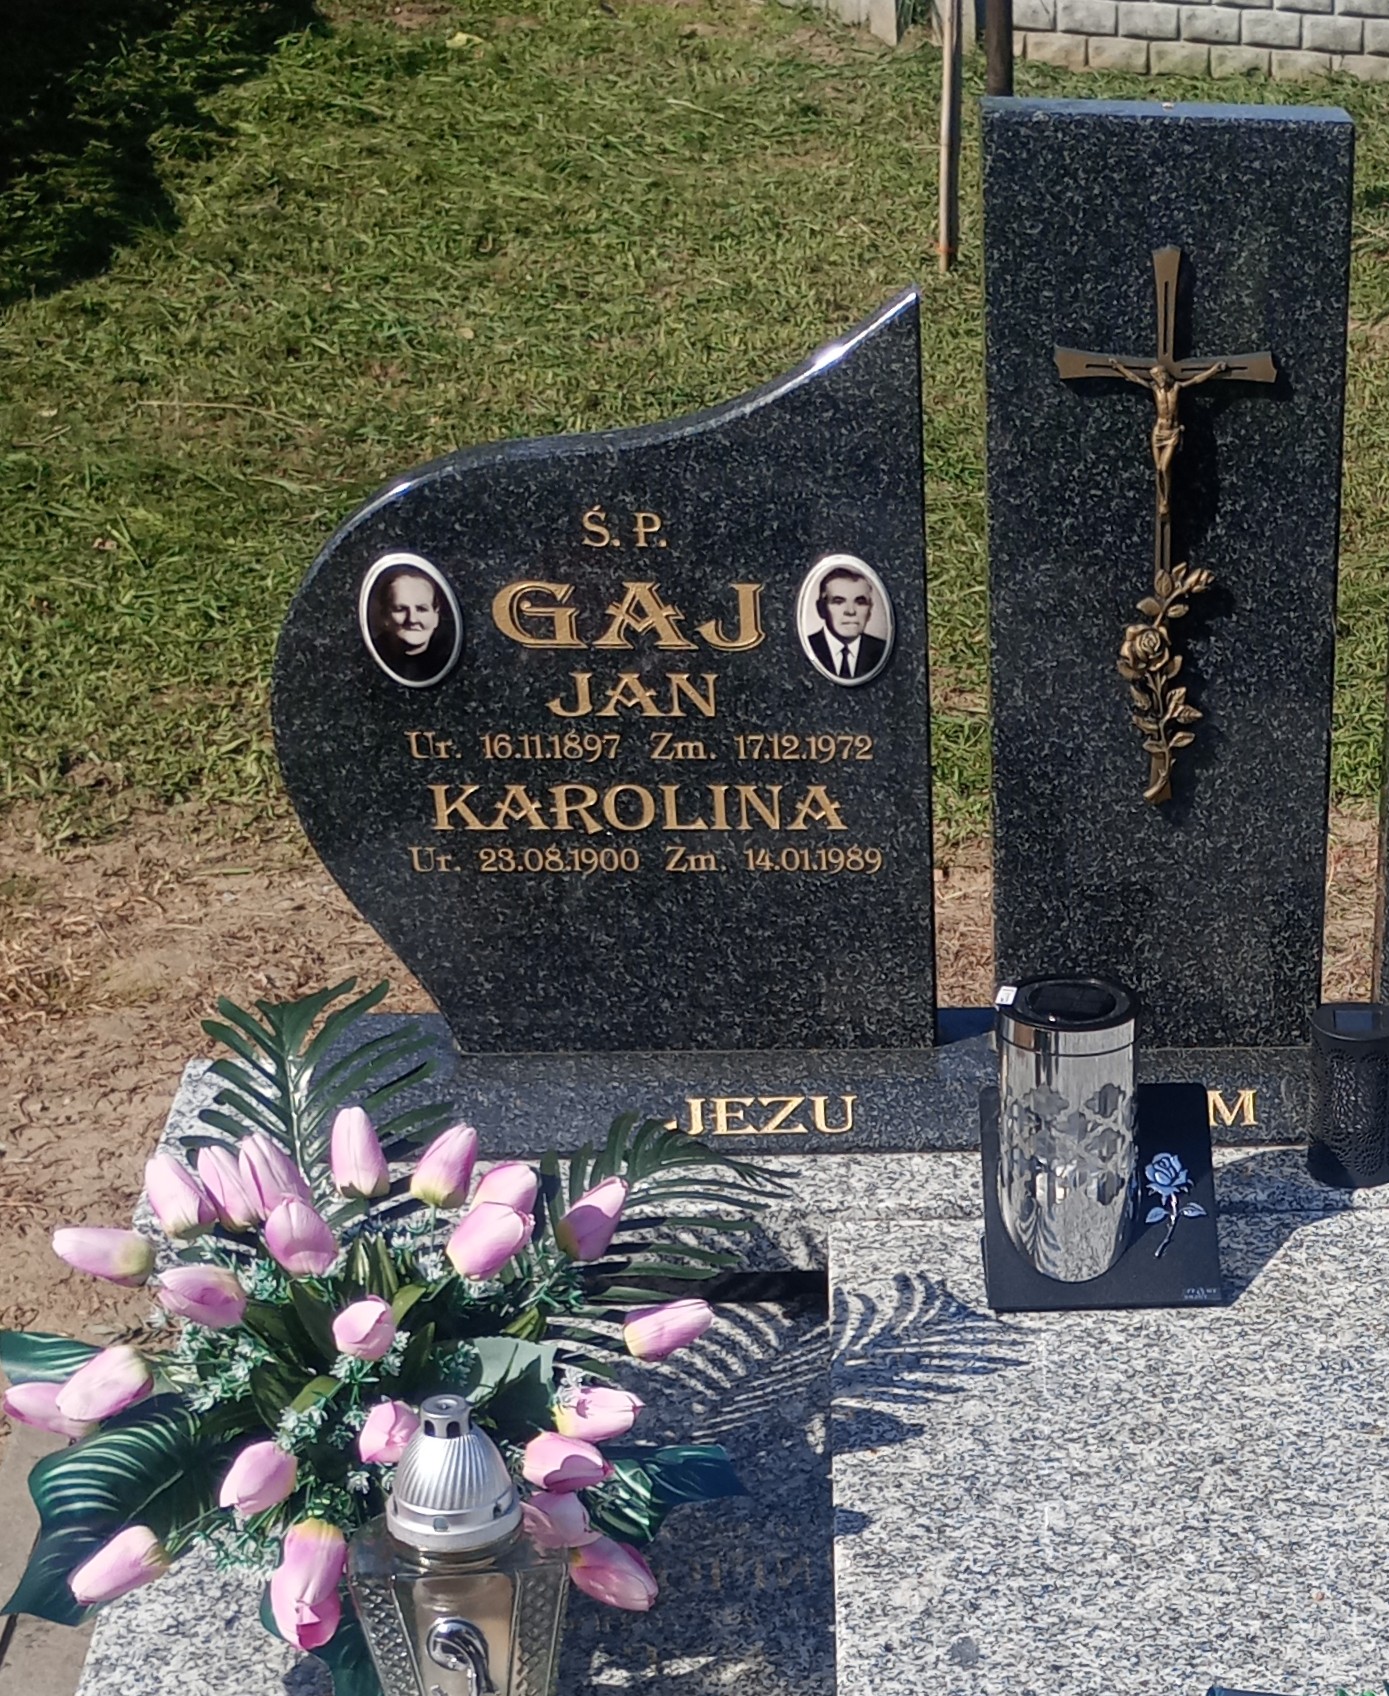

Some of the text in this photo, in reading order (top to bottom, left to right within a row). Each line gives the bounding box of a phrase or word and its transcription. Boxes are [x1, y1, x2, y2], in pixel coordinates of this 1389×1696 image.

[581, 505, 668, 548] Ś. P.
[491, 579, 767, 652] GAJ
[546, 672, 718, 718] JAN
[404, 731, 461, 760] Ur.
[480, 732, 621, 763] 16.11.1897
[650, 732, 716, 761] Zm.
[428, 783, 848, 835] KAROLINA
[409, 845, 884, 875] Ur. 23.08.1900 Zm. 14.01.1989
[663, 1094, 857, 1136] JEZU
